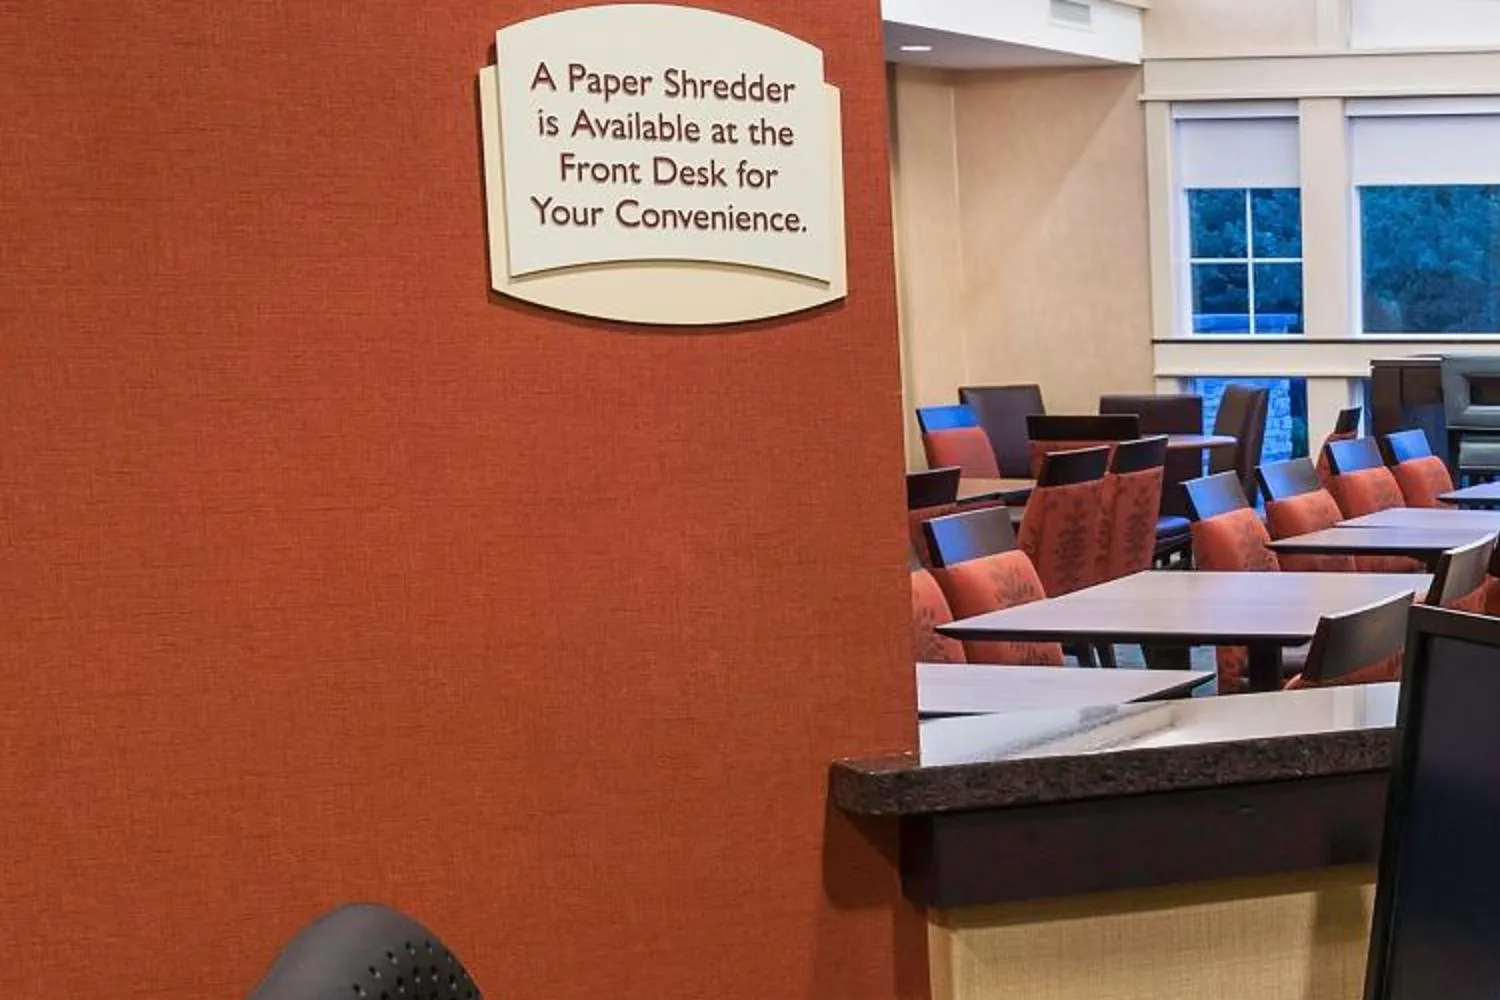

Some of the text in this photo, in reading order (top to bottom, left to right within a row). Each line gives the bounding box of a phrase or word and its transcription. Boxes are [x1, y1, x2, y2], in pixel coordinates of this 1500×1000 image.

[531, 62, 796, 103] A Paper Shredder
[538, 109, 794, 147] is Available at the
[560, 153, 778, 190] Front Desk for
[530, 196, 808, 234] Your Convenience.
